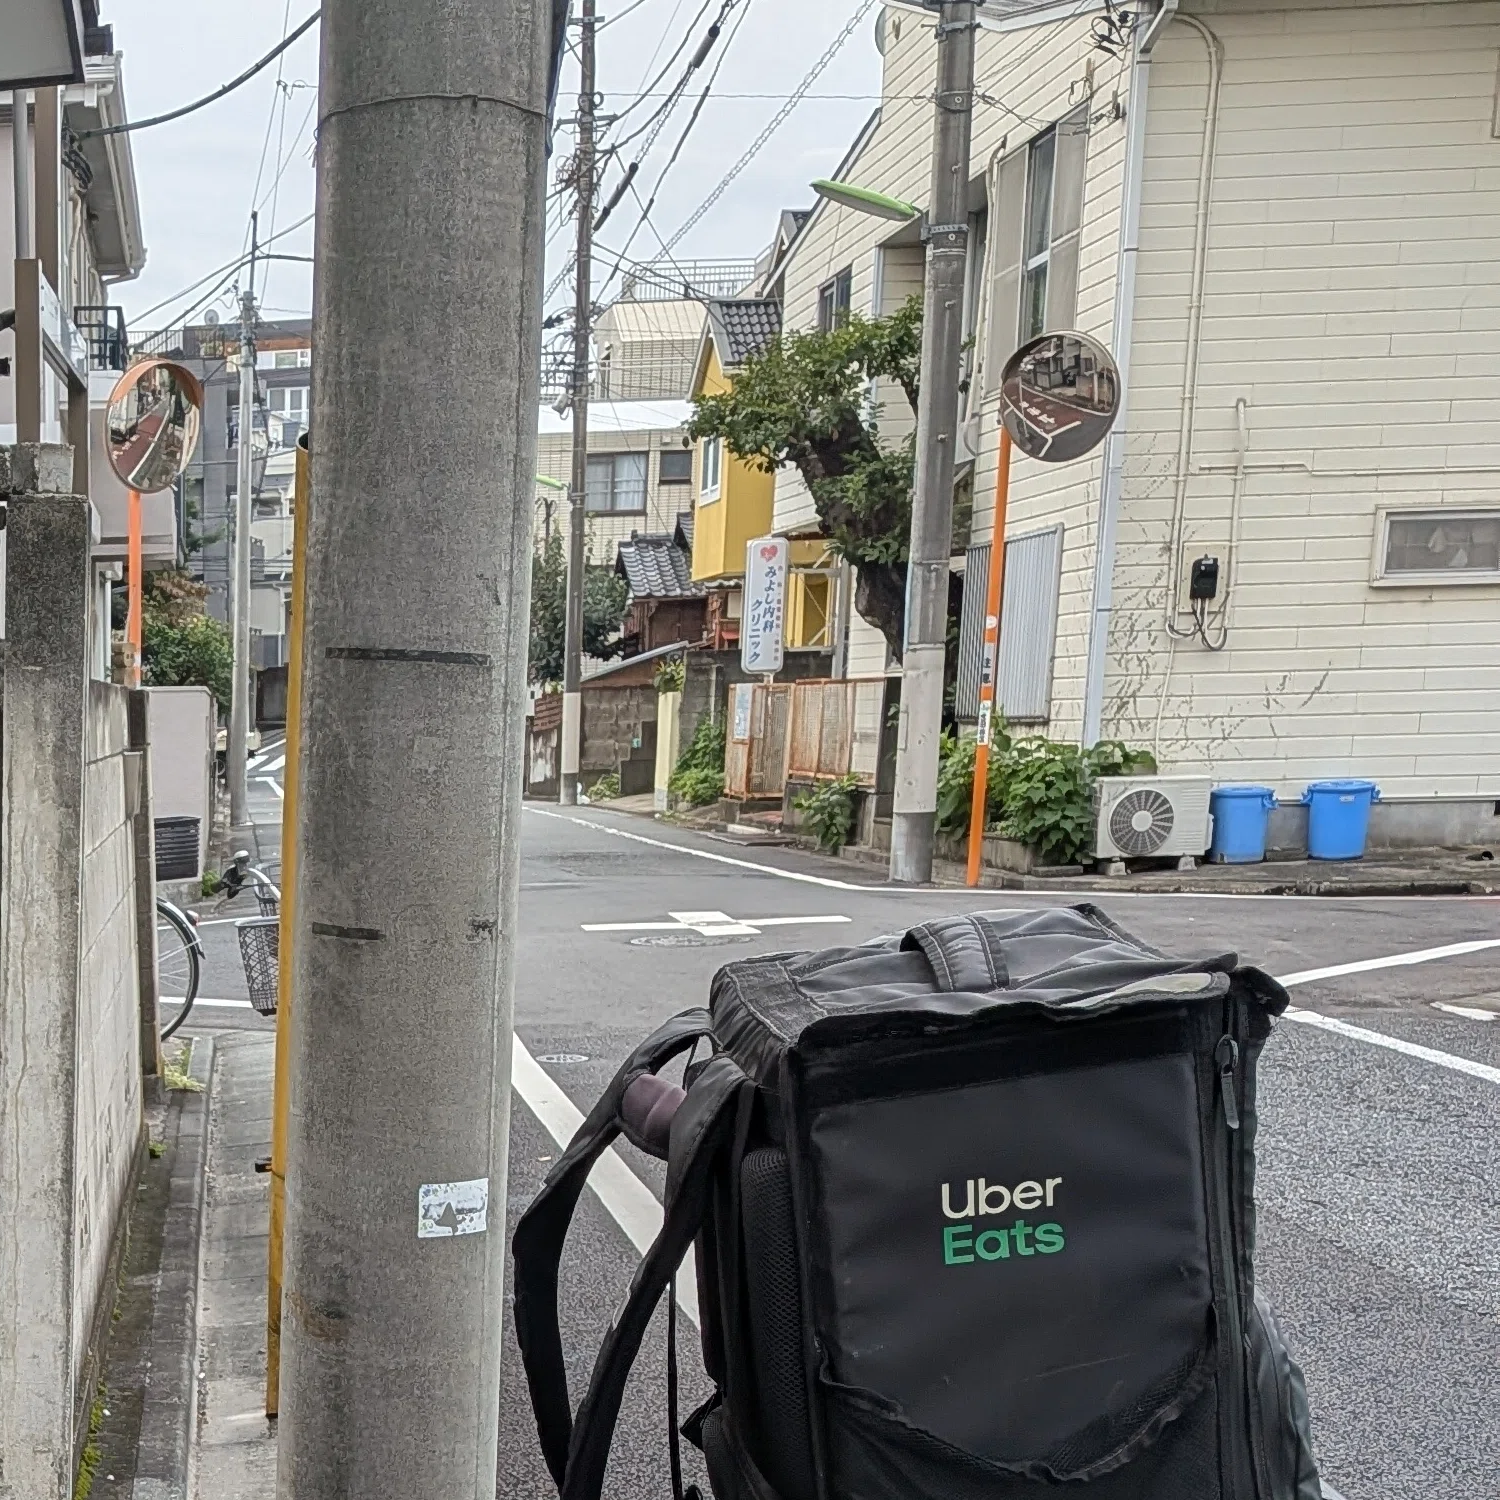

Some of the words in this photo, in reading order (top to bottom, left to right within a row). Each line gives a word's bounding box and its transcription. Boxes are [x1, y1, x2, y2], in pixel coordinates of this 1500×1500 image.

[762, 565, 777, 633] みよし内科
[748, 598, 763, 665] クリニック
[941, 1176, 1063, 1219] Uber
[943, 1219, 1065, 1265] Eats
